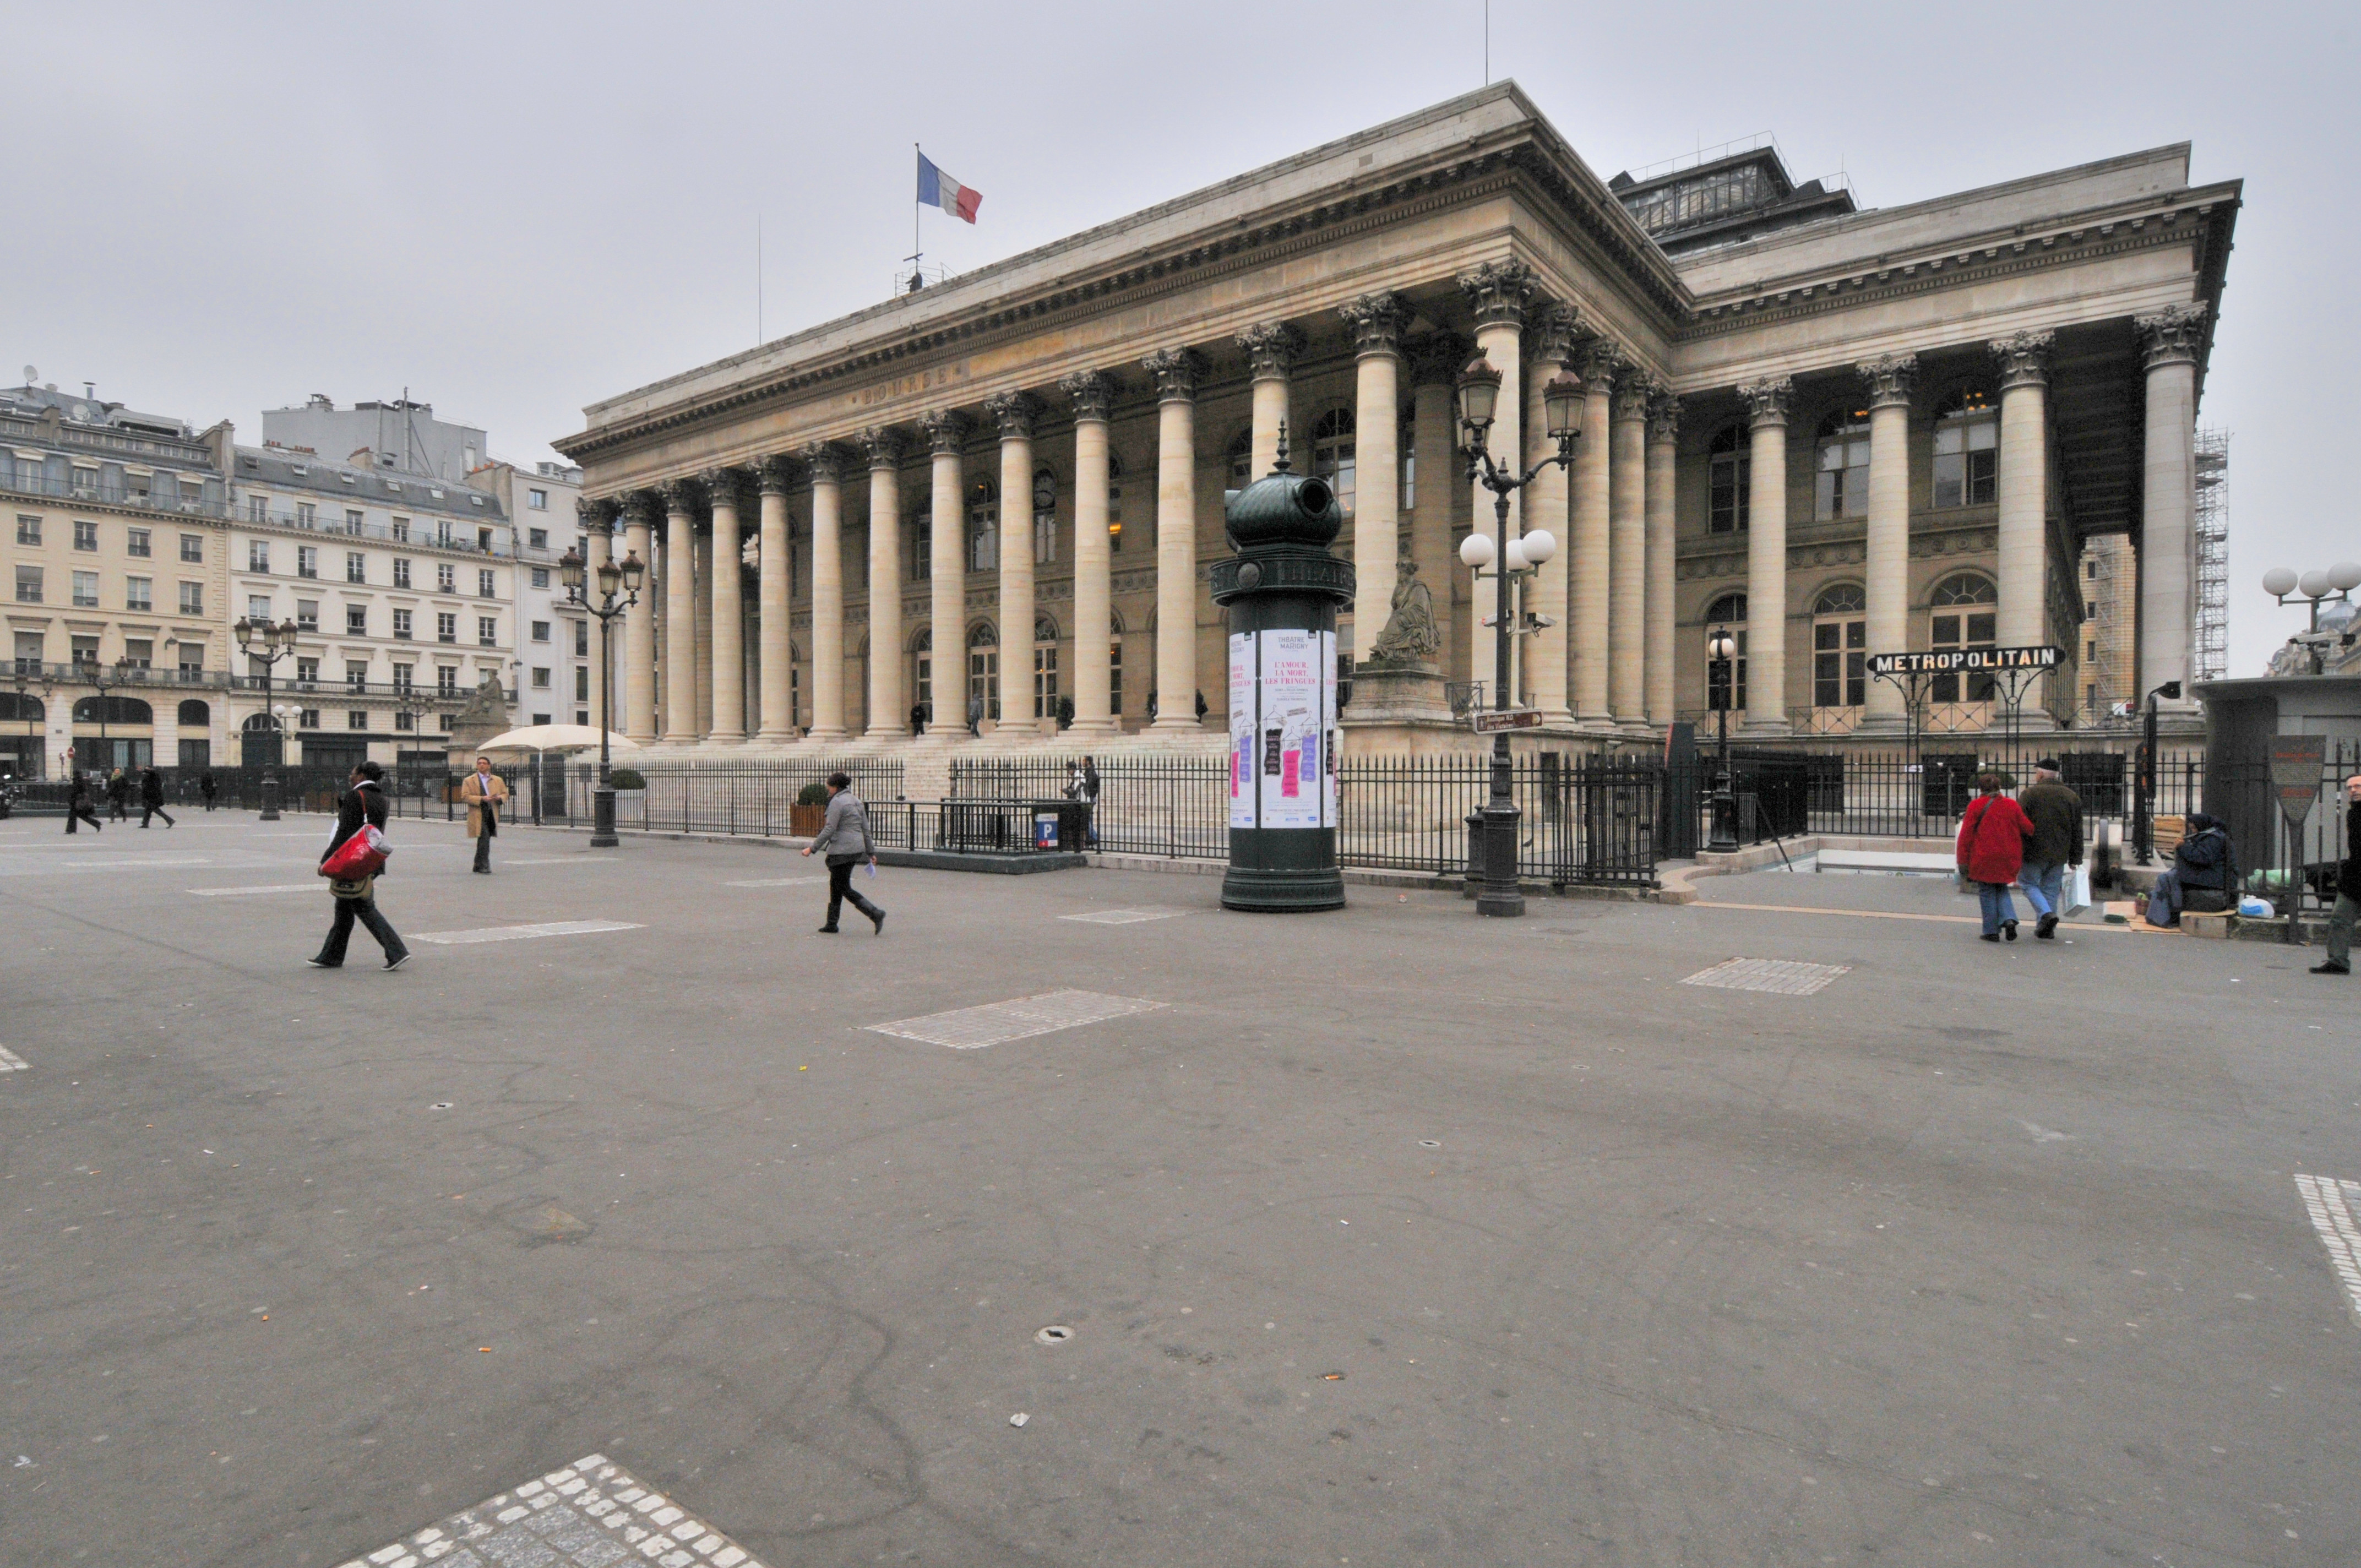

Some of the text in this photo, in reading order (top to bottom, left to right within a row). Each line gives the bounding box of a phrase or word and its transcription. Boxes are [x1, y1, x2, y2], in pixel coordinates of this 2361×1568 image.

[864, 367, 946, 405] BOURSE
[1876, 649, 2055, 672] METROPOLITAIN
[1044, 824, 1052, 838] P
